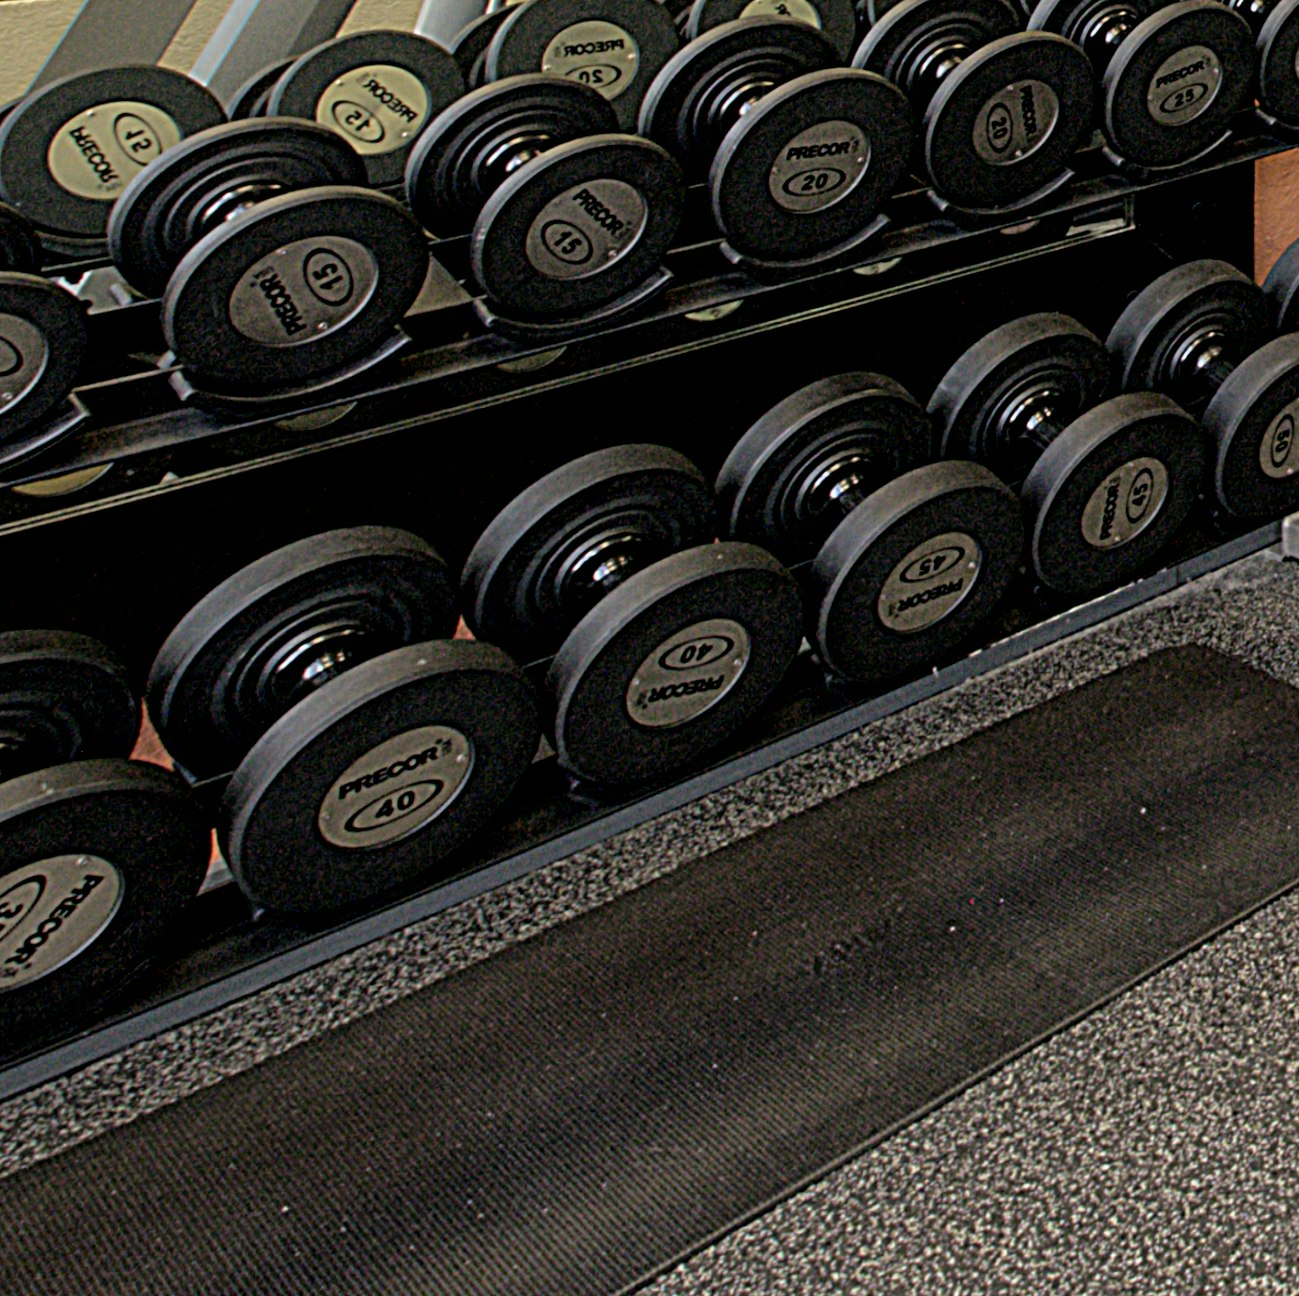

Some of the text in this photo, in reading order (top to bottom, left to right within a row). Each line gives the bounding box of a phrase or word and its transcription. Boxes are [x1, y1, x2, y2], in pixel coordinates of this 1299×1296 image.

[1156, 60, 1204, 88] PRECOR
[1175, 89, 1194, 107] 25
[992, 116, 1008, 139] 20
[786, 141, 850, 161] PRECOR
[801, 173, 828, 191] 20
[572, 188, 624, 239] PRECOR
[554, 231, 582, 254] 15
[312, 263, 344, 290] 15
[259, 273, 307, 336] PRECOR
[1275, 429, 1290, 453] 50
[1132, 483, 1148, 506] 45
[898, 577, 963, 612] PRECOR
[680, 643, 713, 664] 40
[648, 674, 725, 703] PRECOR
[339, 746, 438, 800] PRECOR
[375, 790, 415, 819] 40
[4, 874, 104, 964] PRECOR
